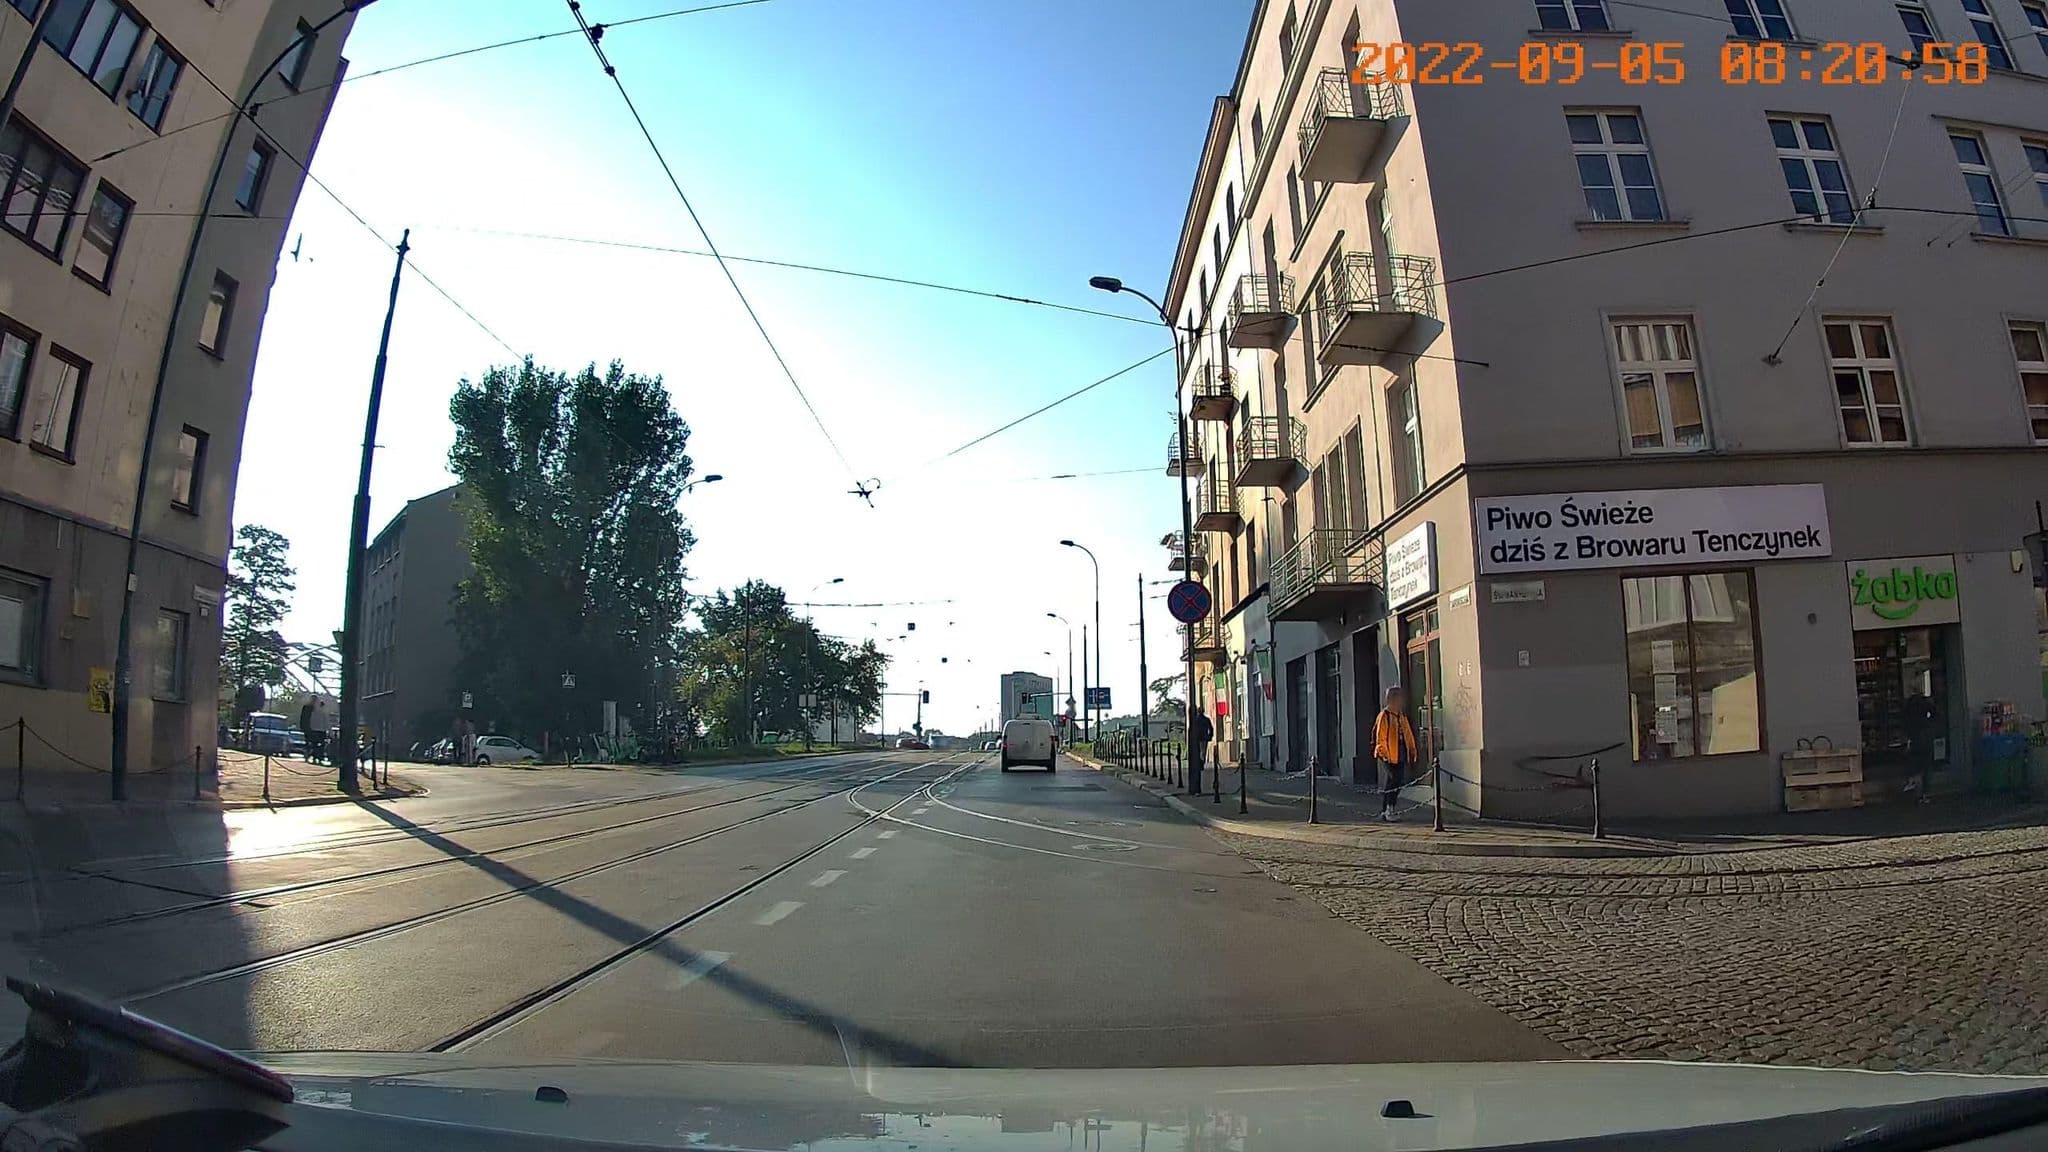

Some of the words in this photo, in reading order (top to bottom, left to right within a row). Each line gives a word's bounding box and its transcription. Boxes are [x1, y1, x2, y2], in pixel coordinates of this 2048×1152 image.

[1486, 507, 1552, 531] Piwo
[1560, 497, 1654, 528] Świeże
[1490, 537, 1546, 564] dziś
[1553, 544, 1569, 560] z
[1576, 535, 1686, 559] Browaru
[1692, 525, 1822, 556] Tenczynek
[1851, 566, 1956, 605] żabka
